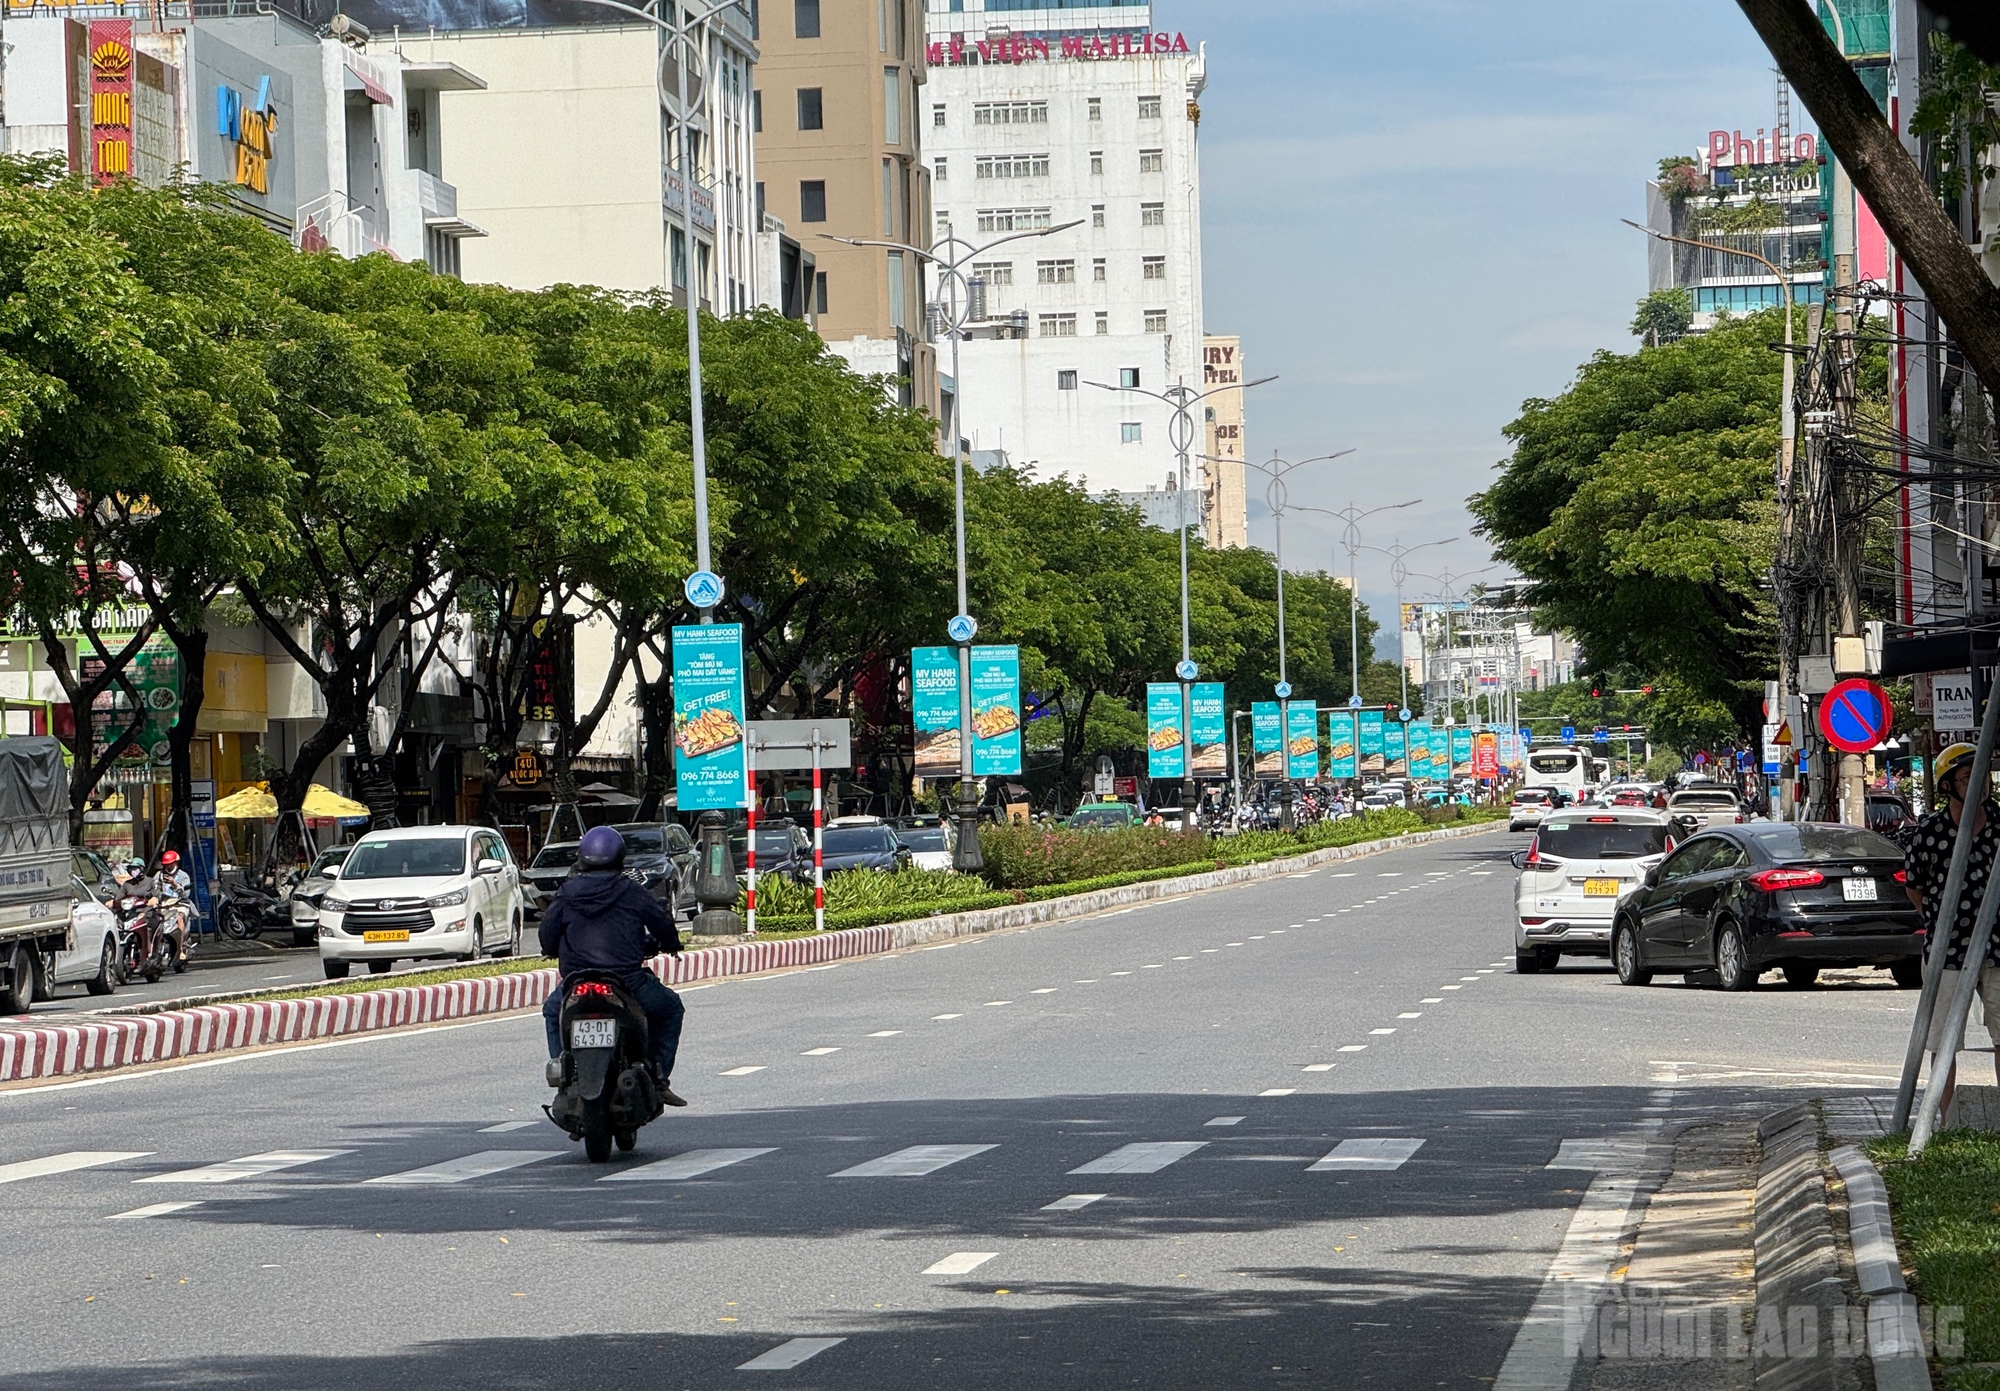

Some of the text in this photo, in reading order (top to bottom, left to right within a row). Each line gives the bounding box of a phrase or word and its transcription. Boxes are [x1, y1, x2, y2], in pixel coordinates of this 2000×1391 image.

[1060, 31, 1191, 60] MAILISA
[707, 628, 738, 637] SEAFOOD
[916, 668, 956, 678] MY HANH
[916, 678, 956, 688] SEAFOOD
[683, 689, 732, 712] GET FREE!
[978, 692, 1011, 708] GET FREE!
[941, 709, 958, 717] 8668
[1192, 705, 1222, 713] SEAFOOD
[681, 770, 739, 781] 096 774 8668
[1587, 887, 1614, 895] 031.21
[574, 1034, 613, 1047] 643.76
